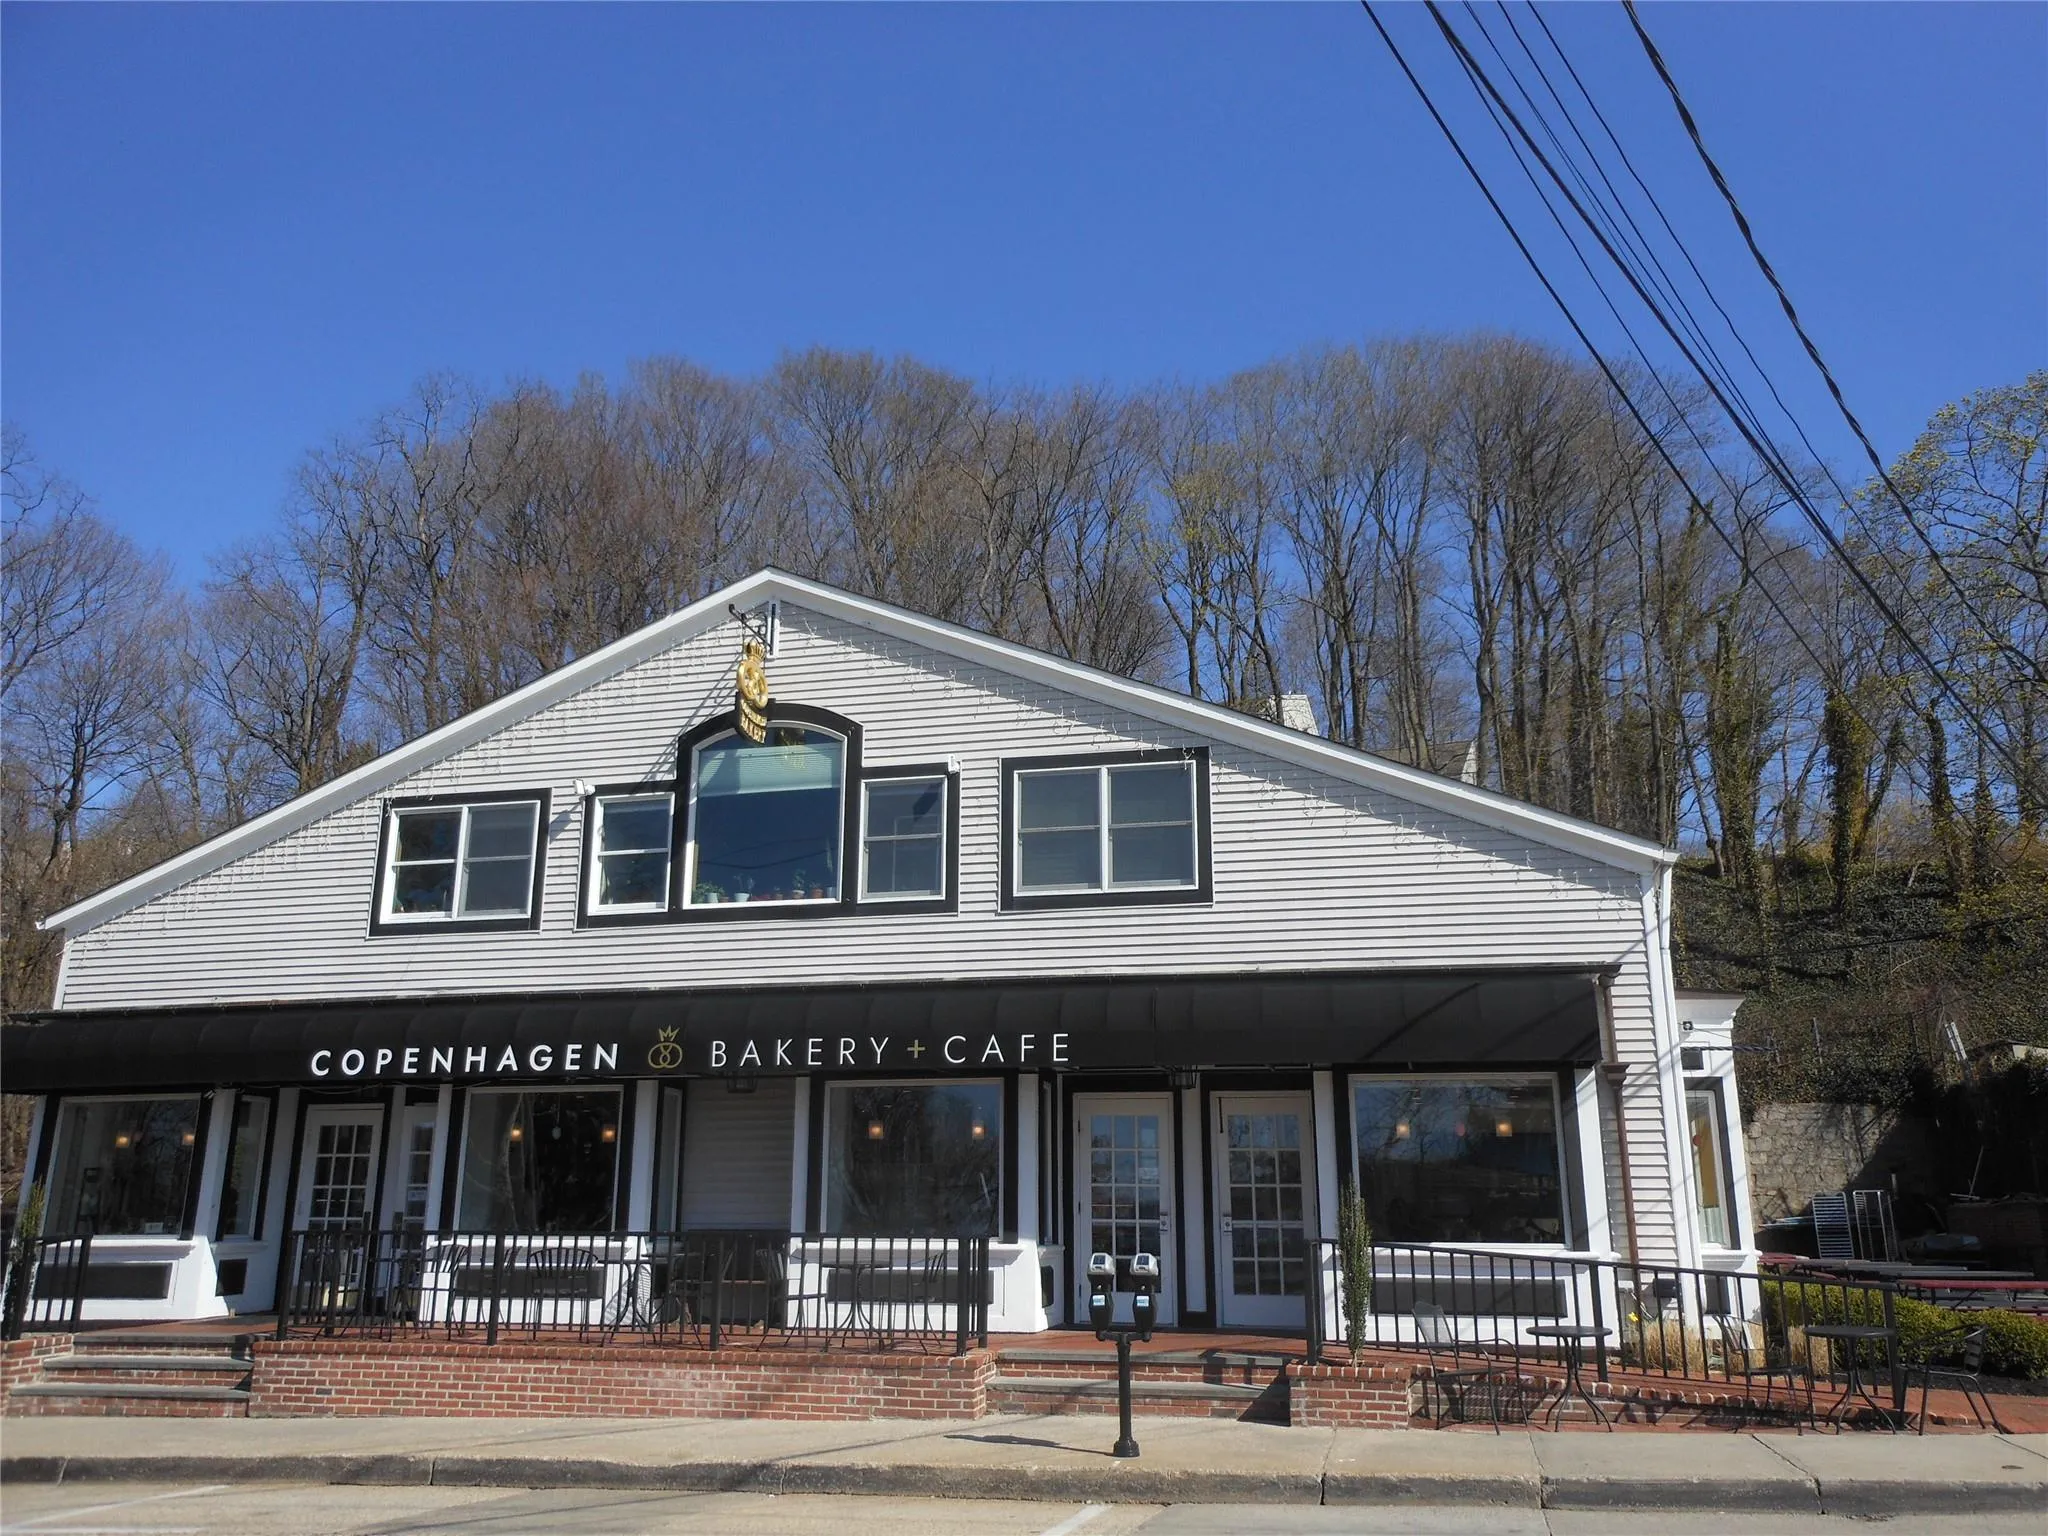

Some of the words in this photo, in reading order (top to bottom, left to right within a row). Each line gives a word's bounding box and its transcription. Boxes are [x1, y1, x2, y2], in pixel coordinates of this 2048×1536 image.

[310, 1043, 618, 1076] COPENHAGEN
[711, 1036, 889, 1067] BAKERY
[944, 1034, 1069, 1064] CAFE
